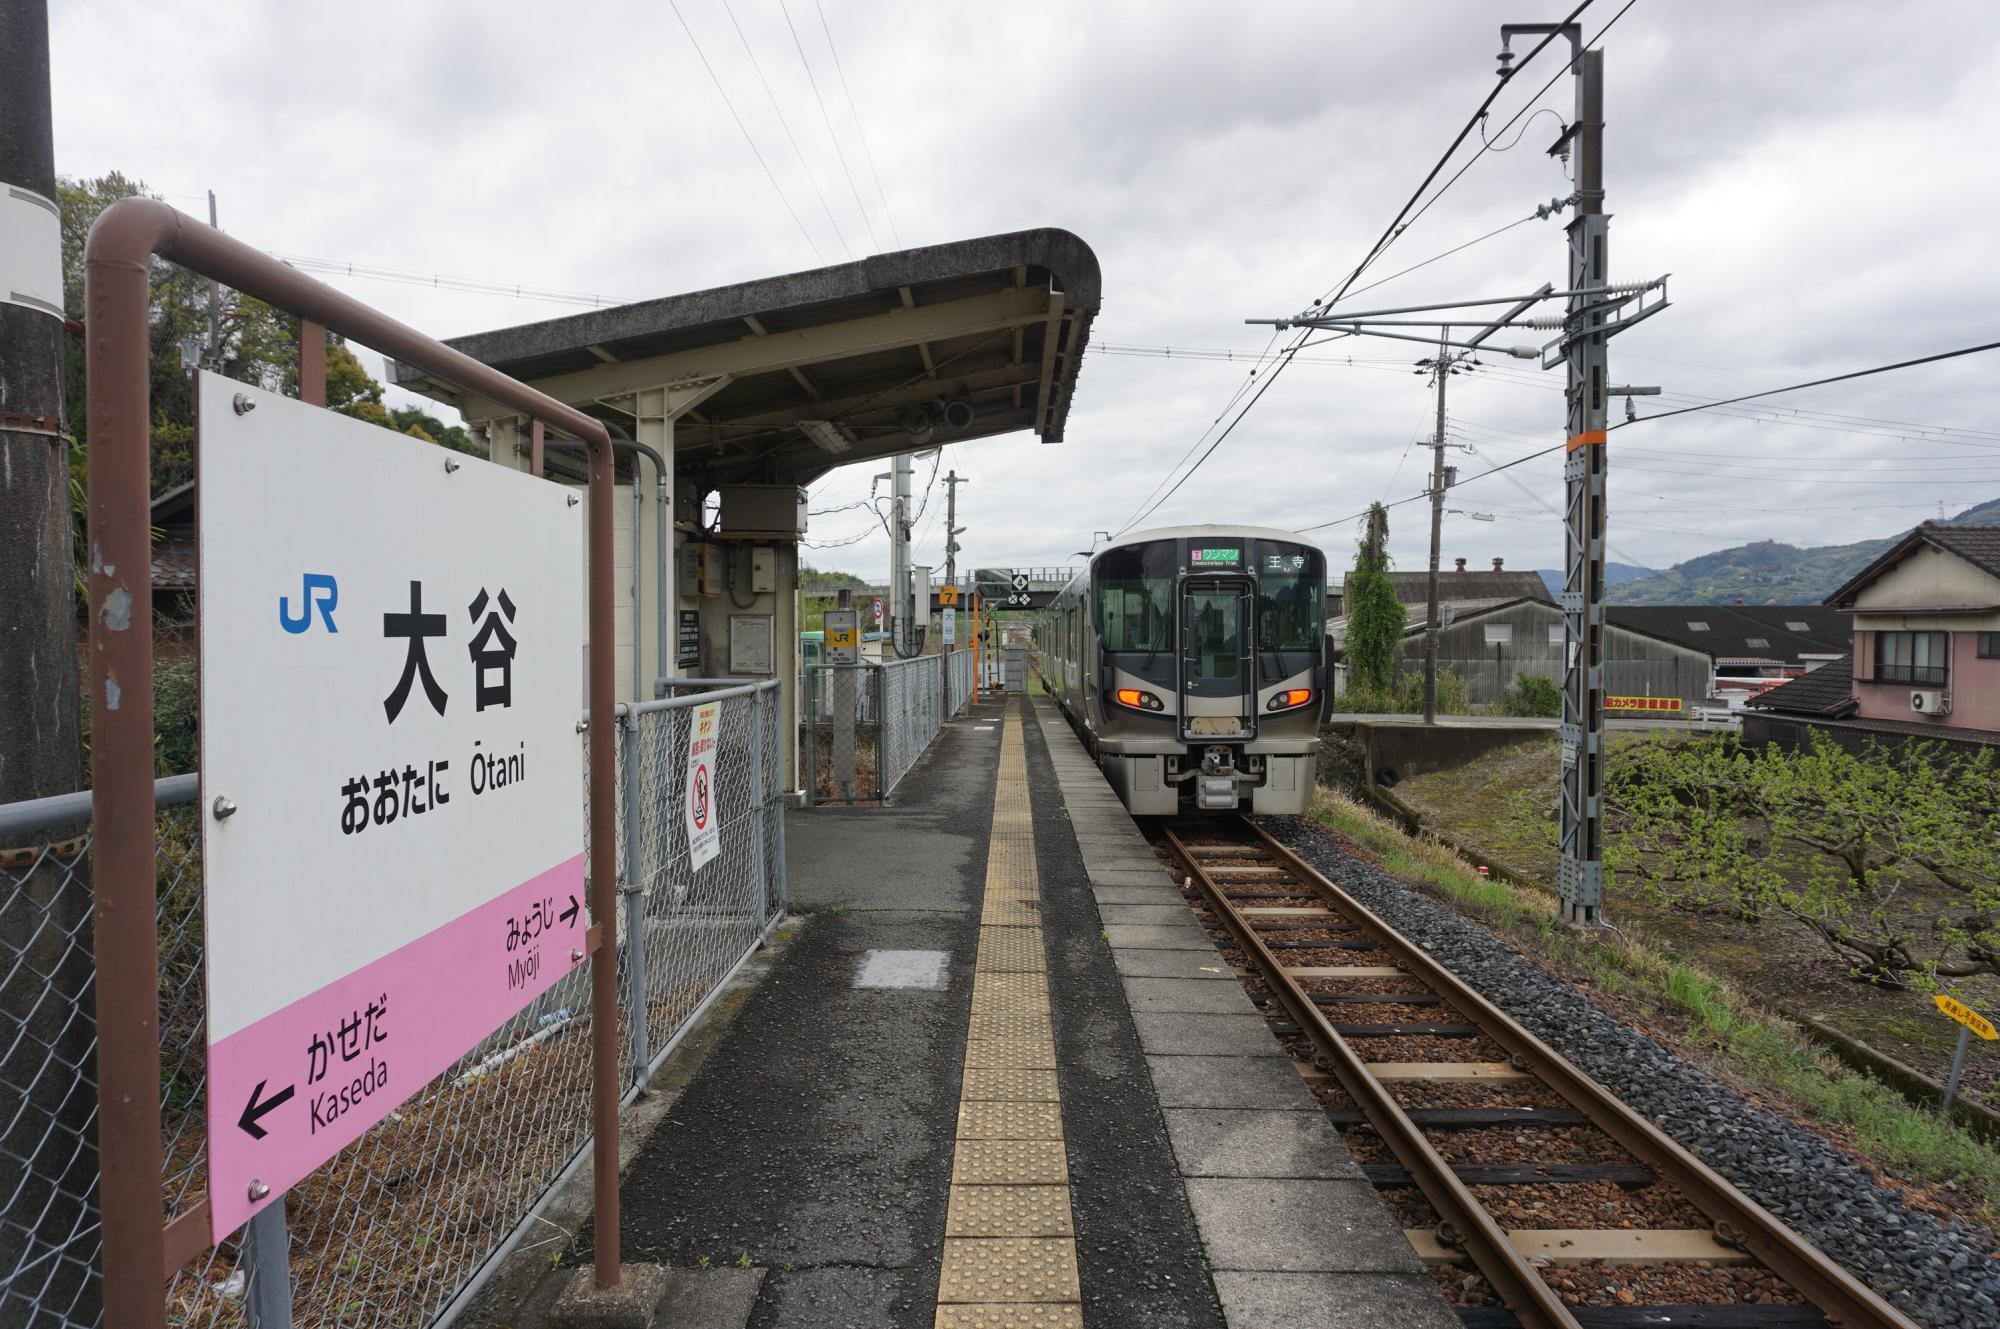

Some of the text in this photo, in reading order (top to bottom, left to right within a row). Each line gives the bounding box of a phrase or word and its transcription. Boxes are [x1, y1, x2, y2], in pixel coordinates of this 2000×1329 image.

[1203, 549, 1238, 560] ワンマン
[1269, 555, 1304, 568] 王寺
[279, 573, 338, 634] JR
[944, 593, 953, 603] 7
[1017, 578, 1023, 587] 4
[384, 581, 517, 724] 大谷
[834, 633, 849, 642] JR
[341, 741, 525, 835] おおたに Ōtani
[506, 896, 554, 952] みょうじ
[508, 944, 540, 991] Myōji
[307, 993, 388, 1085] かせだ
[310, 1057, 388, 1135] Kaseda
